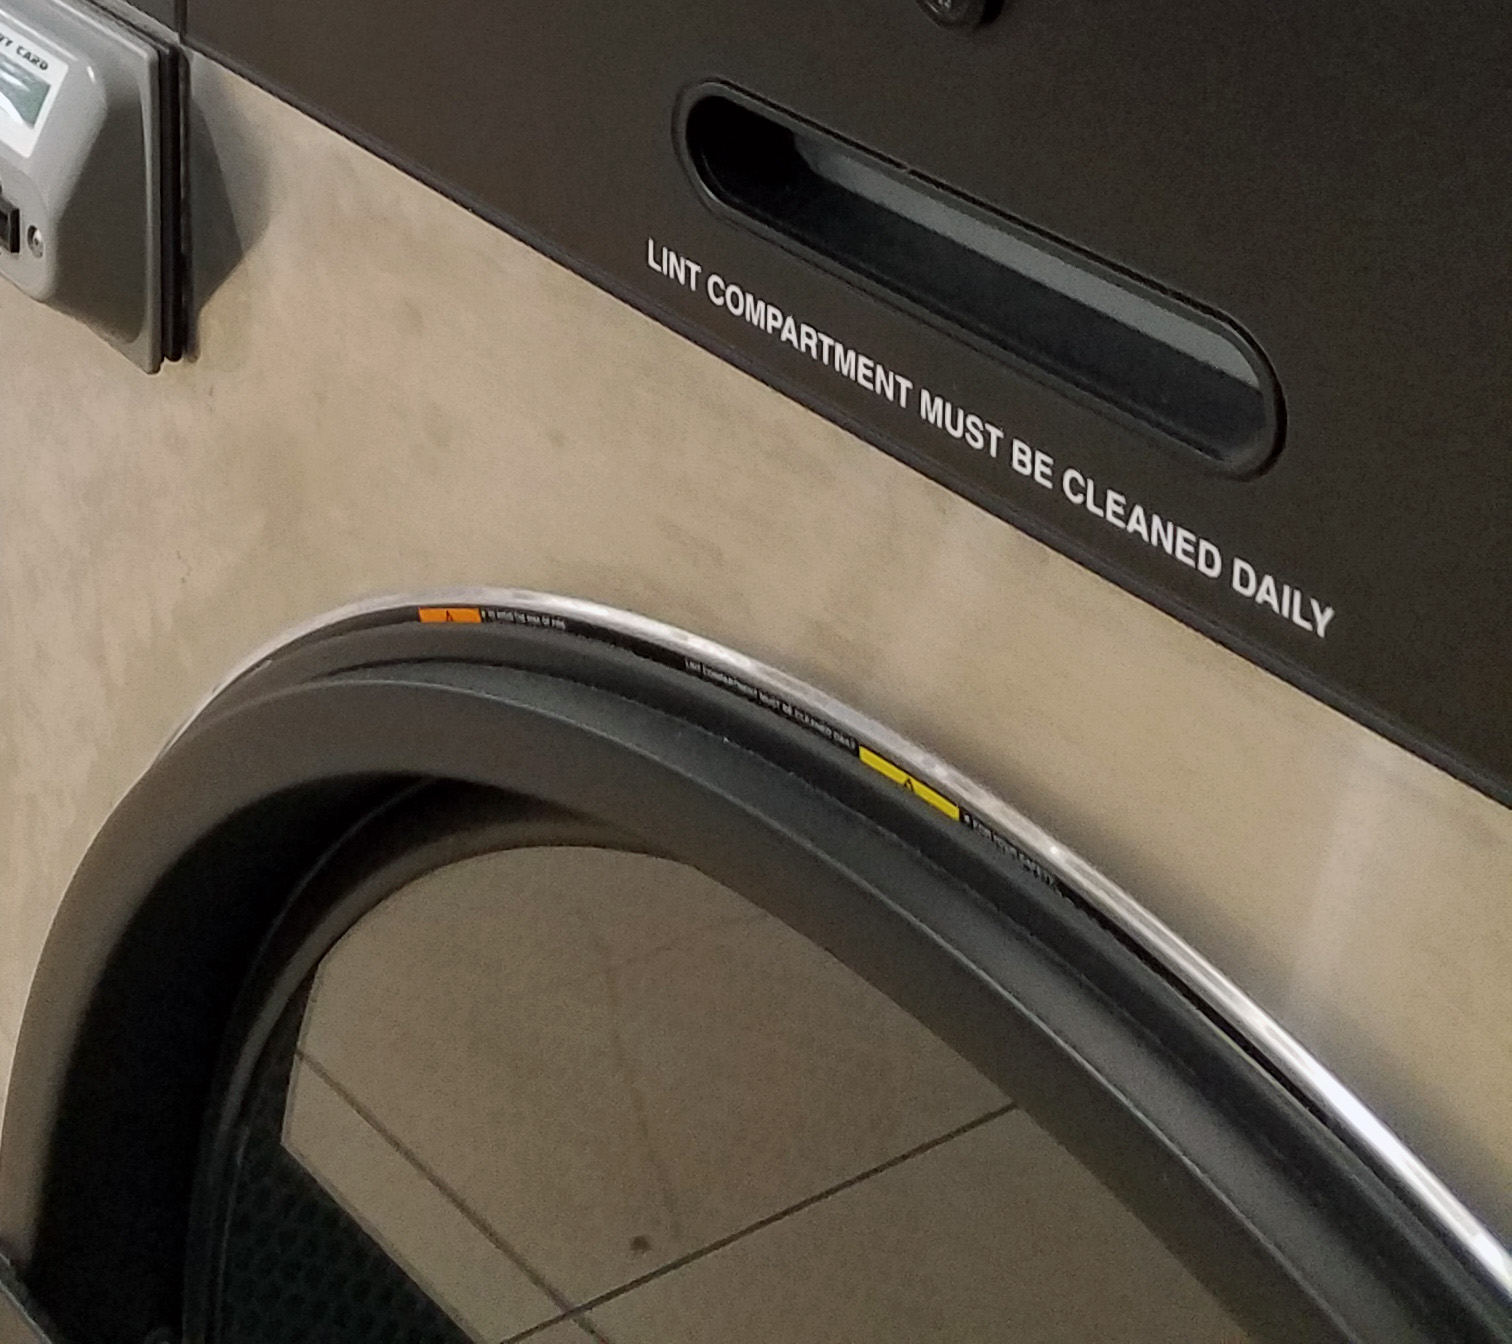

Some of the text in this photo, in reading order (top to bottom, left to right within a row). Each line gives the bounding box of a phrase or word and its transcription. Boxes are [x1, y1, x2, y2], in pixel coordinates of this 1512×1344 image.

[15, 45, 49, 71] CARD
[647, 237, 1336, 639] LINT COMPARTMENT MUST BE CLEANED DAILY
